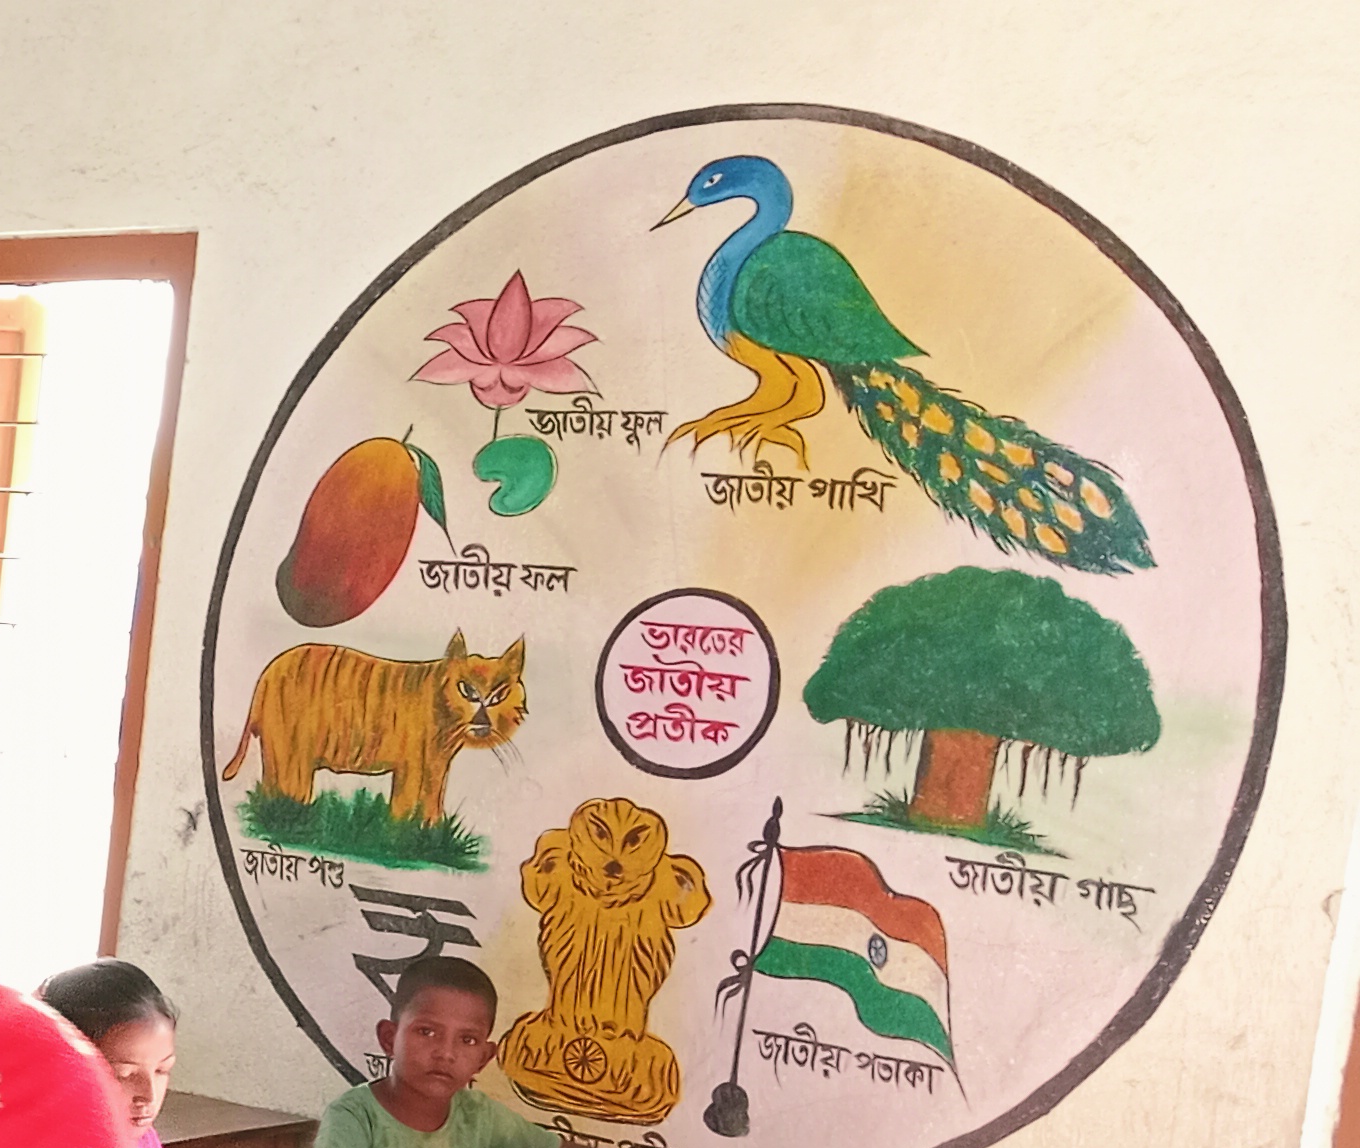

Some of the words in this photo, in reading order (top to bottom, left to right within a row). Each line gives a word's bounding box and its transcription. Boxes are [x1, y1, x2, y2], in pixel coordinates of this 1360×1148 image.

[525, 396, 617, 441] জাতীয়
[619, 409, 670, 455] ফুল
[701, 460, 803, 511] জাতীয়
[808, 464, 899, 514] পাখি
[419, 543, 517, 598] জাতীয়
[520, 563, 578, 594] ফল
[639, 620, 756, 657] ভারতের
[618, 653, 752, 702] জাতীয়
[625, 702, 741, 746] প্রতীক
[240, 842, 307, 885] জাতীয়
[308, 854, 345, 889] পশু
[945, 851, 1070, 908] জাতীয়
[1075, 876, 1157, 932] গাছ
[752, 1021, 851, 1080] জাতীয়
[854, 1050, 947, 1095] পতাকা
